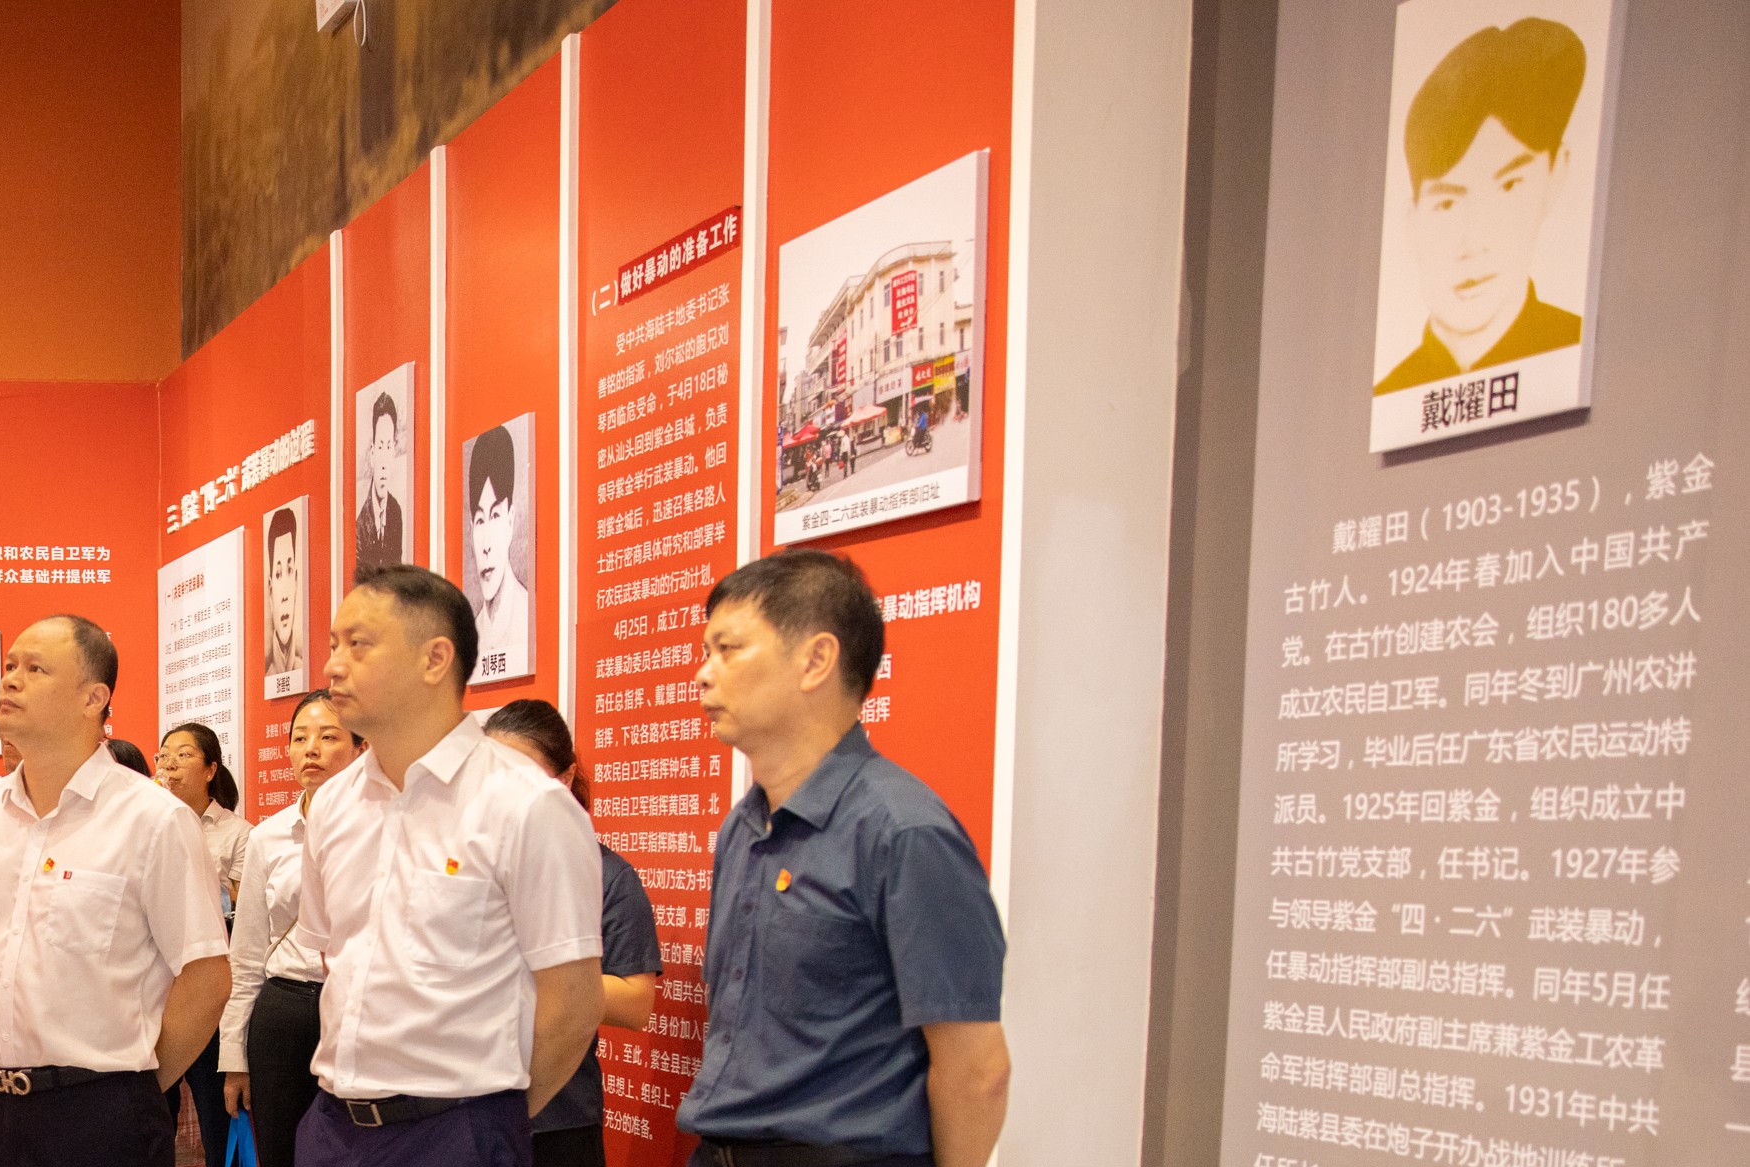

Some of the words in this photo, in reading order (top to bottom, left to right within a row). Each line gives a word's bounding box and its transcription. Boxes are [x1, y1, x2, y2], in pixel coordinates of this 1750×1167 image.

[616, 282, 730, 356] 受中共海陆丰地委书记张
[598, 362, 728, 434] 琴西临危受命，于4月18日秘
[1420, 371, 1520, 433] 戴耀田
[598, 402, 728, 469] 密从汕头回到紫金县城，负责
[597, 442, 727, 505] 领导紫金举行武装暴动。他回
[597, 481, 726, 540] 到紫金城后，迅速召集各路人
[597, 520, 725, 574] 士进行密商具体研究和部署举
[1283, 518, 1710, 615] 古竹人。1924年春加入中国共产
[597, 562, 715, 610] 行农民武装暴动的行动计划。
[875, 580, 981, 622] 暴动指挥机构
[1280, 586, 1701, 669] 党。在古竹创建农会，组织180多人
[481, 652, 506, 676] 刘琴西
[1277, 652, 1697, 720] 成立农民自卫军。同年冬到广州农讲
[858, 696, 891, 723] 指挥
[594, 754, 721, 783] 路农民自卫军指挥钟乐善，西
[1275, 716, 1692, 773] 所学习，毕业后任广东省农民运动特
[594, 792, 720, 817] 路农民自卫军指挥黄国强，北
[1272, 782, 1686, 826] 派员。1925年回紫金，组织成立中
[1270, 845, 1681, 885] 共古竹党支部，任书记。1927年参
[1265, 949, 1671, 1011] 任暴动指挥部副总指挥。同年5月任
[642, 1012, 710, 1042] 员身份加入
[1262, 1000, 1666, 1073] 紫金县人民政府副主席兼紫金工农革
[1259, 1051, 1661, 1136] 命军指挥部副总指挥。1931年中共
[603, 1108, 653, 1140] 充分的准备。
